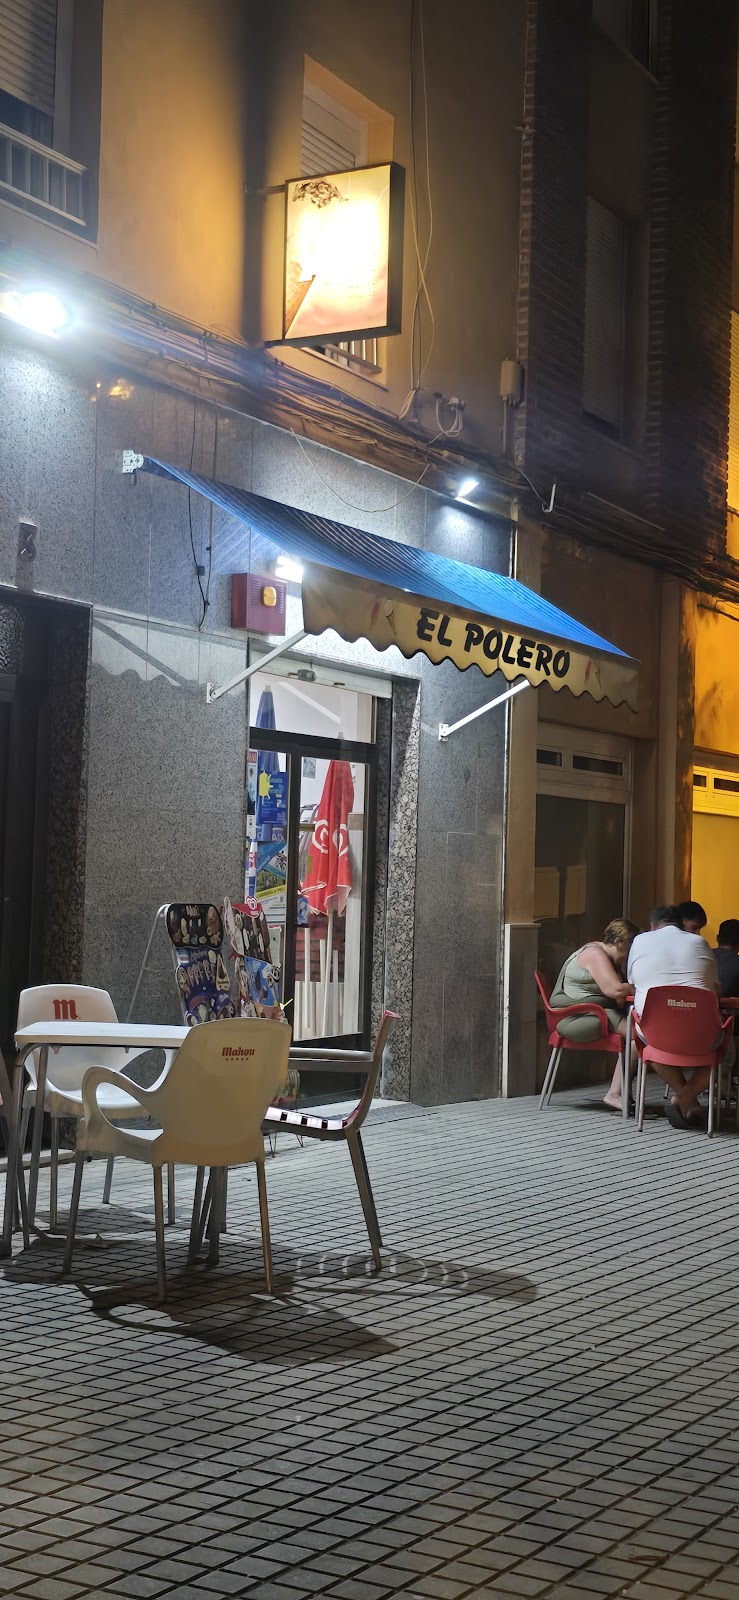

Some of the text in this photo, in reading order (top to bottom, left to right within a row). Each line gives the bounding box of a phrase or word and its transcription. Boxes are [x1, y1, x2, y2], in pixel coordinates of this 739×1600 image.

[416, 607, 571, 679] EL POLERO
[667, 999, 697, 1008] Mahou
[221, 1047, 255, 1057] Mahou
